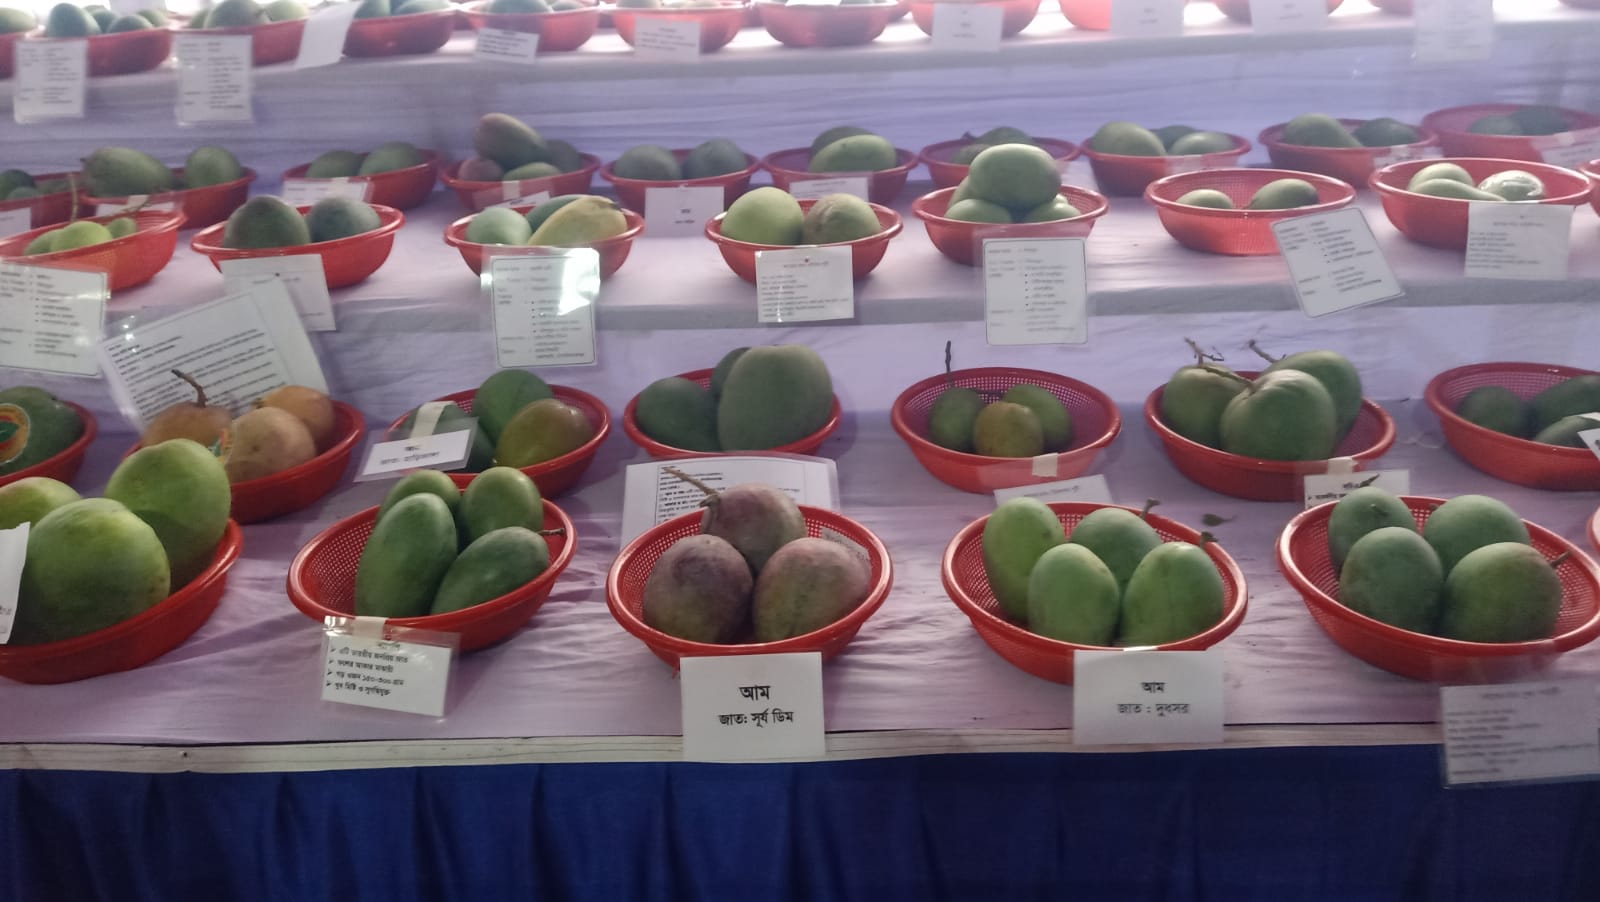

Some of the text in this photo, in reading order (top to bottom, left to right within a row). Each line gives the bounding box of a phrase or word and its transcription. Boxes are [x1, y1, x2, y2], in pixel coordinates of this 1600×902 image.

[739, 684, 771, 701] আম
[1141, 681, 1166, 693] আম
[751, 708, 769, 728] সূর্য
[772, 708, 794, 724] ডিম
